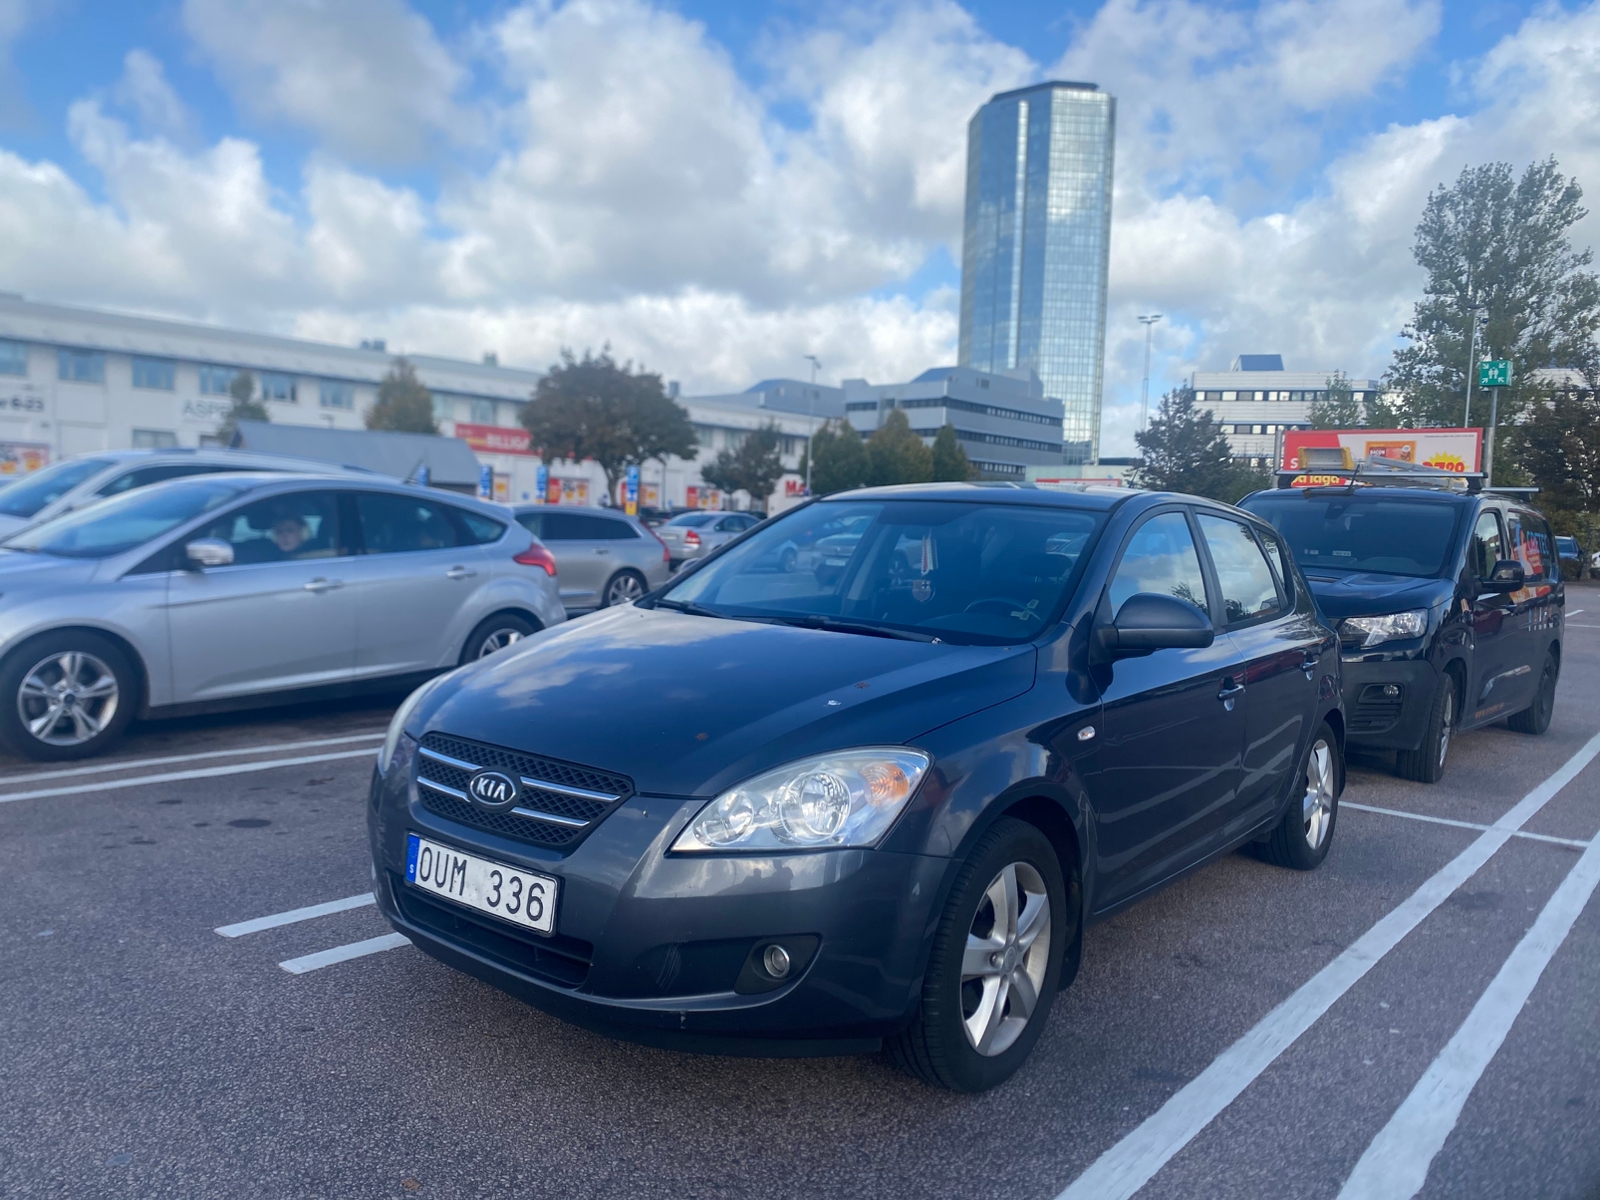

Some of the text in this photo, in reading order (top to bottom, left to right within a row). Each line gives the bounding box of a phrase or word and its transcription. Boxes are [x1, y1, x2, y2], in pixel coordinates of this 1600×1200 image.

[476, 777, 506, 802] KIA
[409, 864, 415, 874] S
[419, 846, 546, 922] OUM 336
